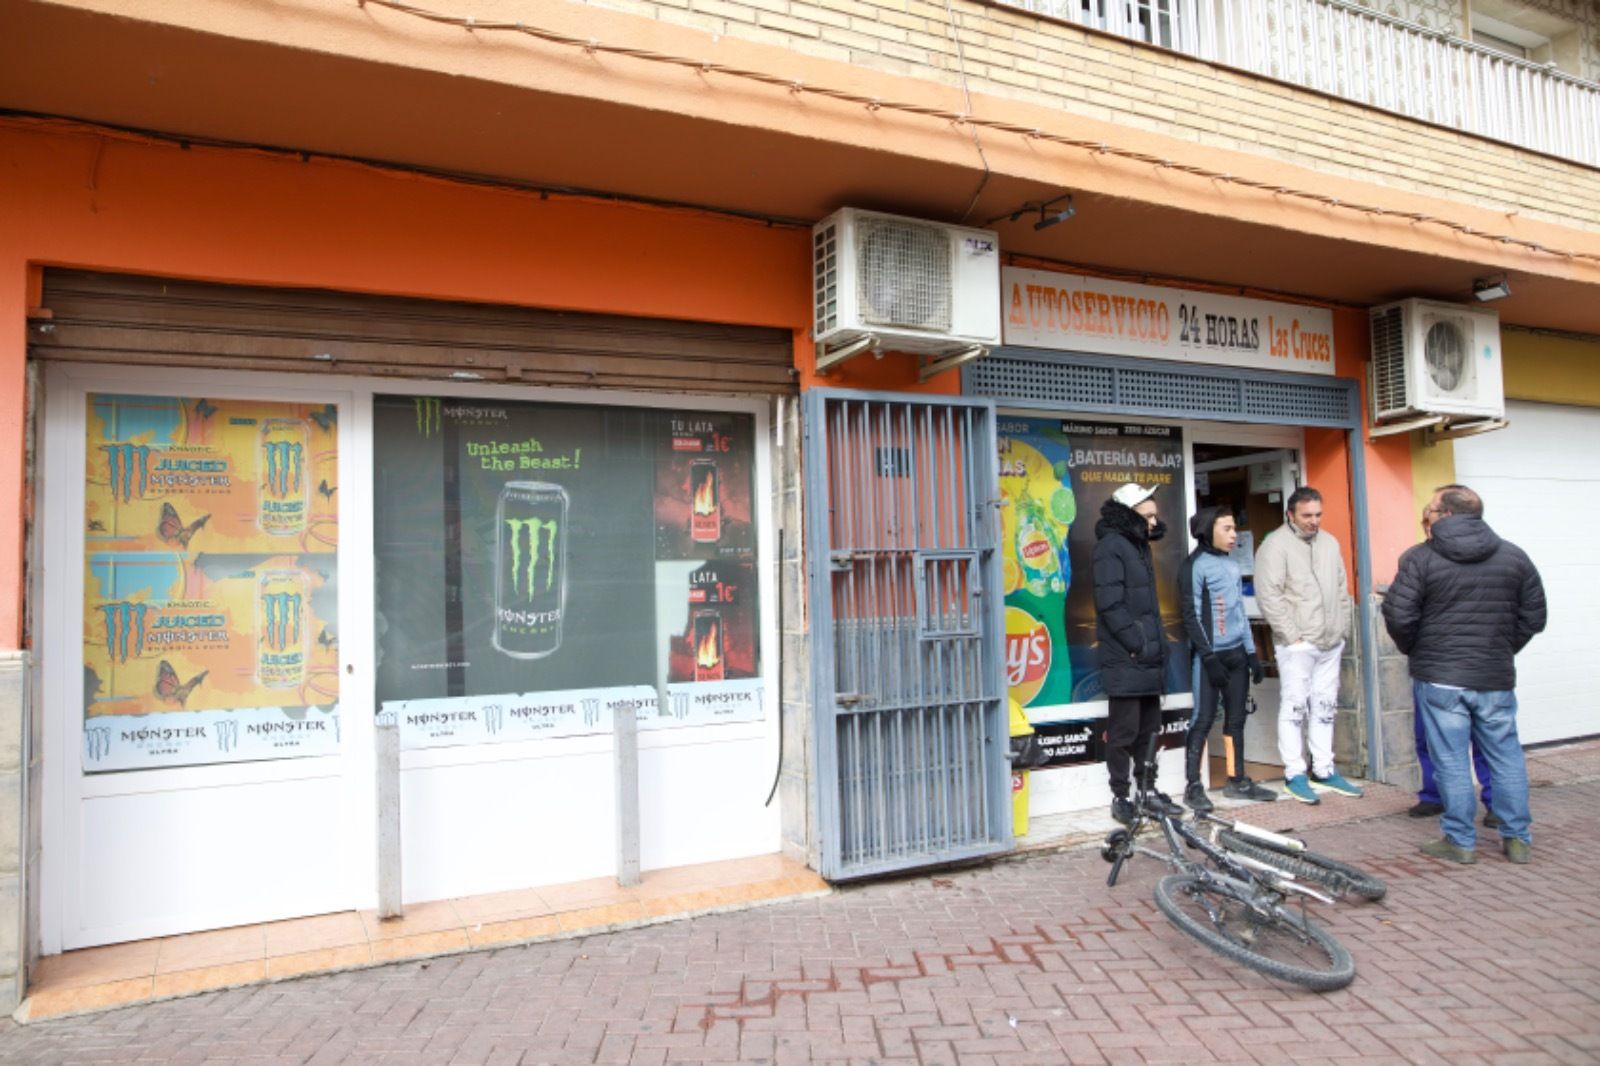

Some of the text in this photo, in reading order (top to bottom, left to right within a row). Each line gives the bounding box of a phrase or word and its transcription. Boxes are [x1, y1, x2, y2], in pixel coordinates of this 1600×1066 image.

[1009, 282, 1330, 362] AUTOSERVICIO 24 HORAS Las Cruces
[671, 420, 713, 432] TU LATA
[466, 438, 544, 457] Unleash
[481, 449, 582, 471] the Beast!
[1068, 448, 1182, 468] ¿BATERÍA BAJA?
[154, 459, 228, 472] JUICED
[1080, 471, 1172, 484] QUE NADA TE PARE
[692, 572, 718, 583] LATA
[152, 615, 226, 628] JUICED
[147, 631, 229, 644] MONSTER
[407, 711, 477, 725] MONSTER
[510, 704, 576, 718] MONSTER
[121, 727, 206, 742] MONSTER
[247, 720, 326, 735] MONSTER
